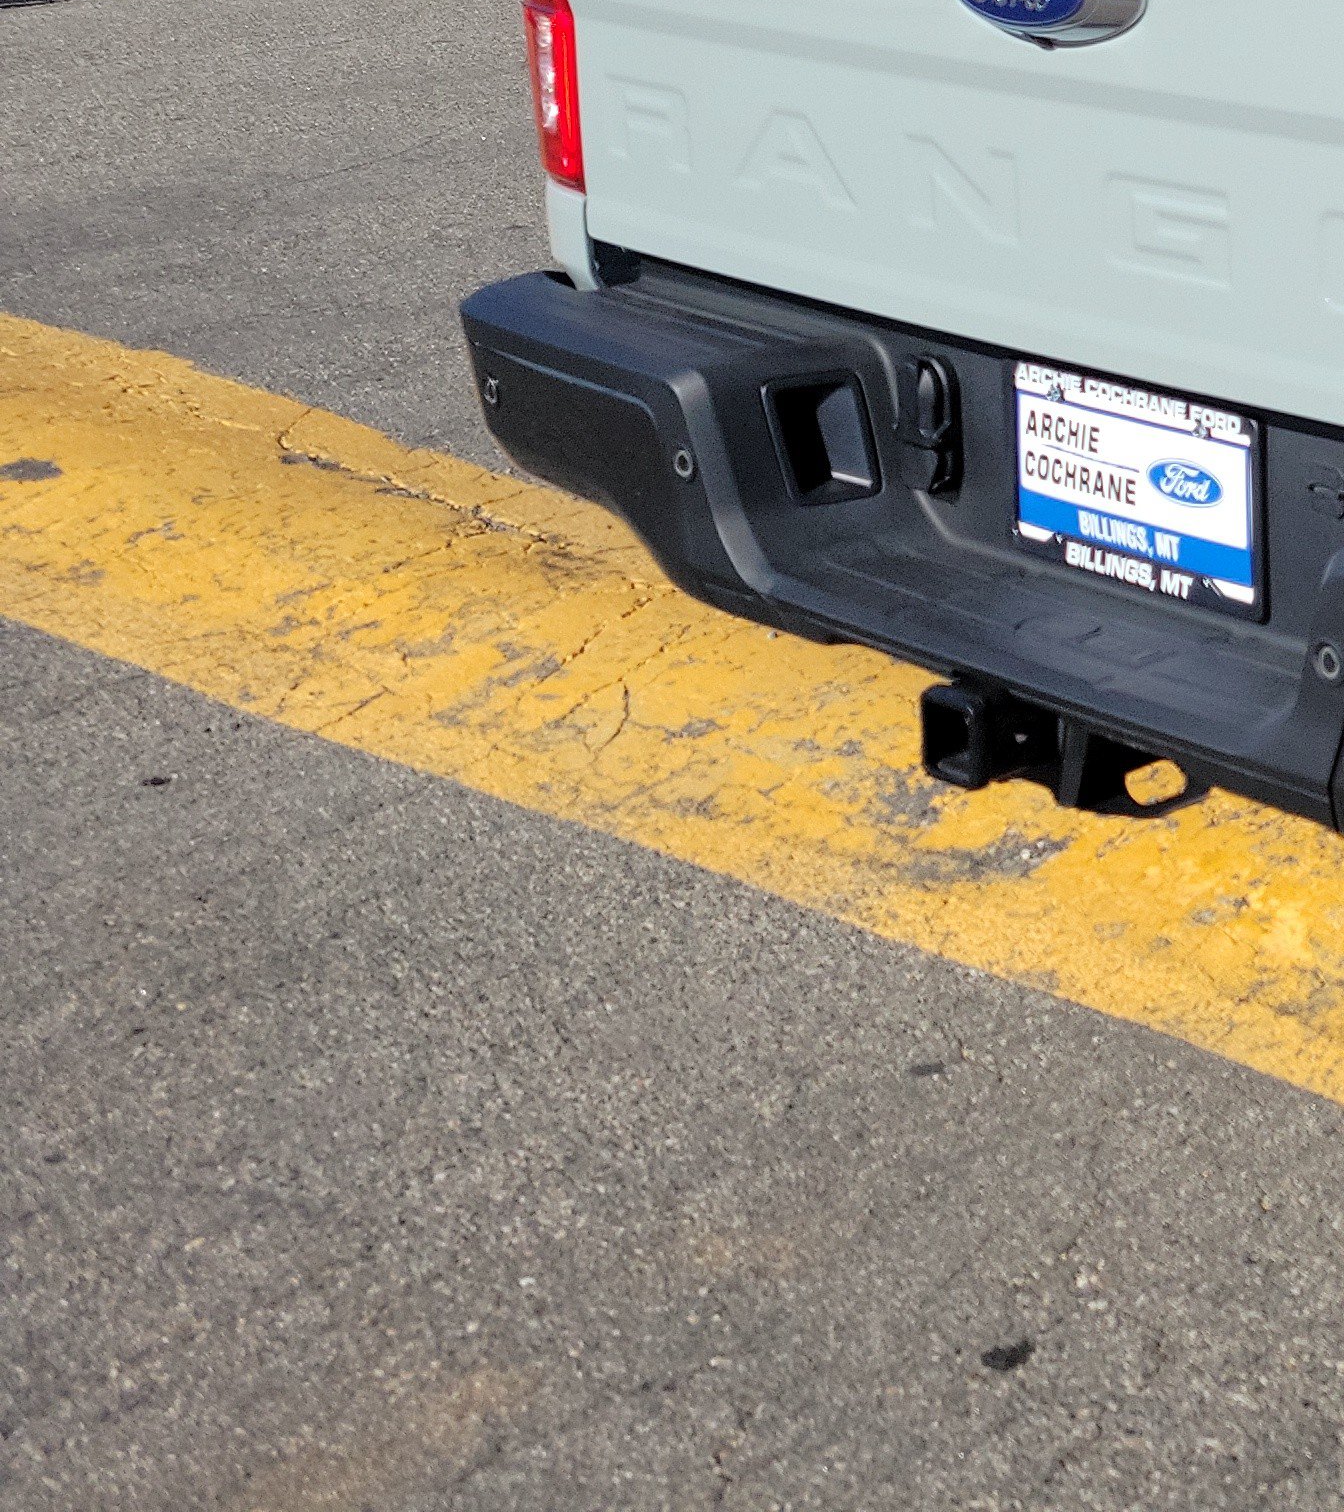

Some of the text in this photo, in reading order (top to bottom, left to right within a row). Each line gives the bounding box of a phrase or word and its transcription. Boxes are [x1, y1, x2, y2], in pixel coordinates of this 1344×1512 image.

[1016, 362, 1242, 434] ARCHIE COCHRANE FORD
[1025, 409, 1101, 454] ARCHIE
[1024, 450, 1137, 507] COCHRANE
[1160, 463, 1211, 502] Ford
[1077, 509, 1181, 563] BILLINGS, MT
[1065, 542, 1194, 599] BILLINGS, MT
